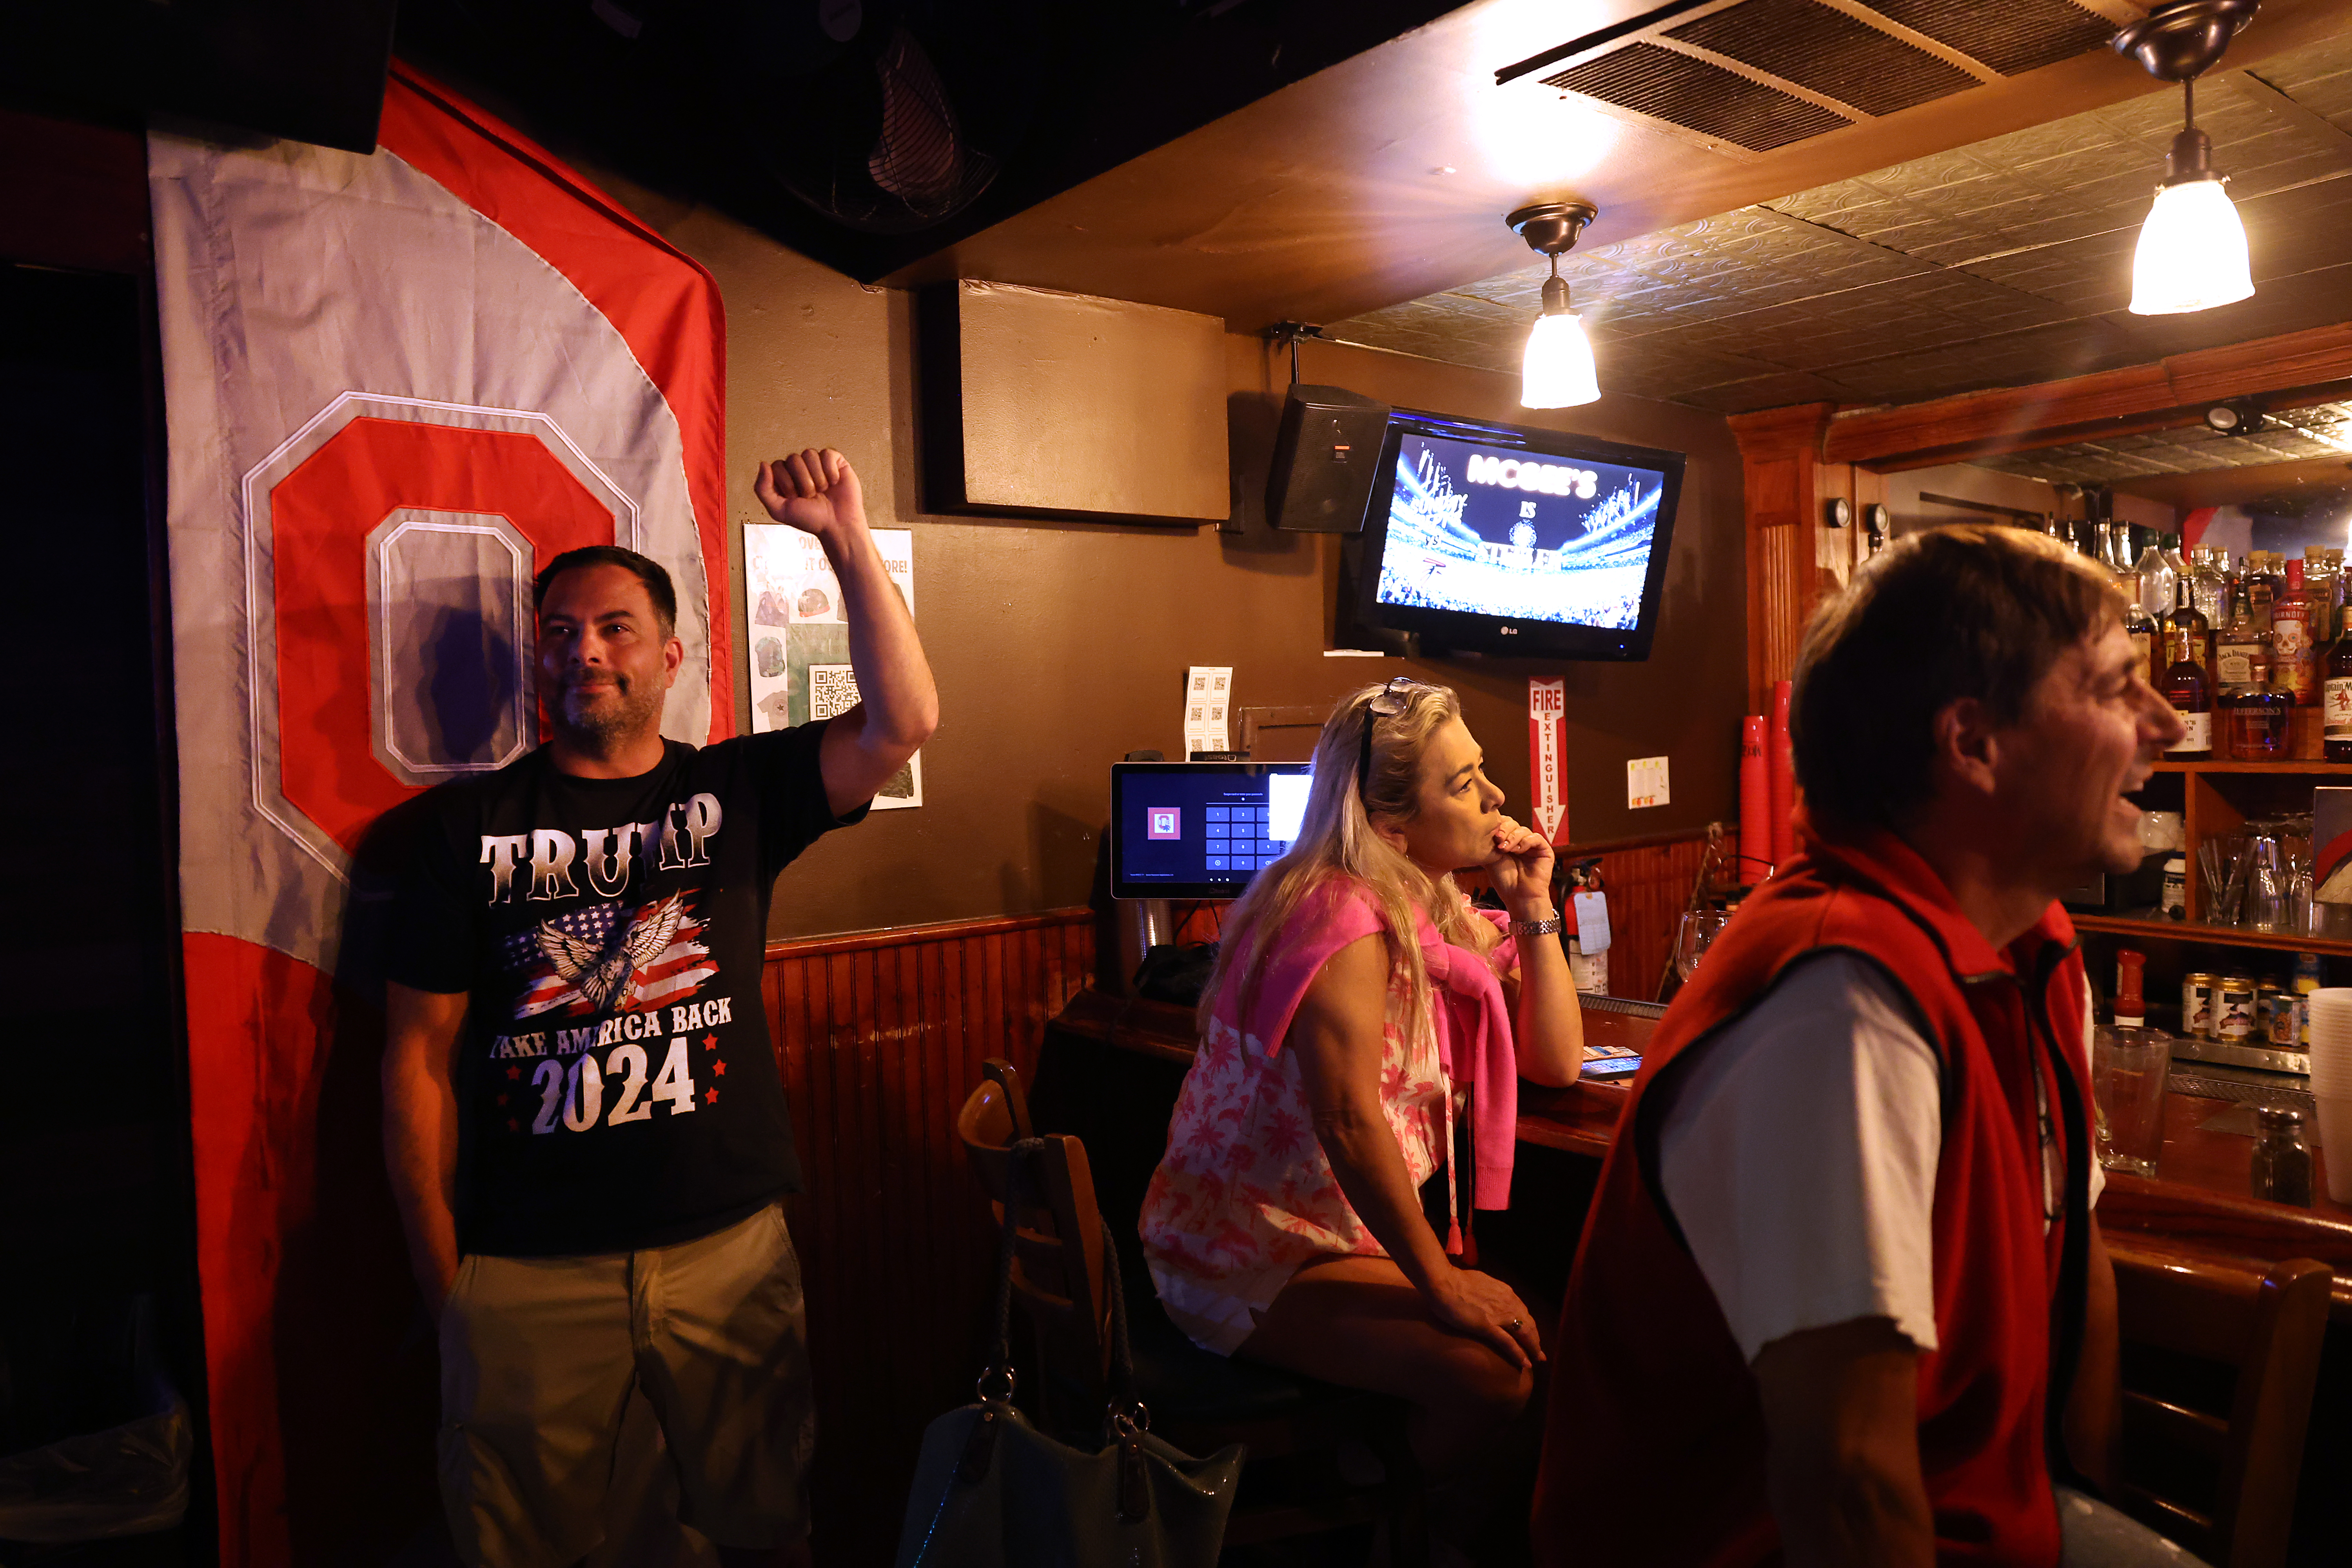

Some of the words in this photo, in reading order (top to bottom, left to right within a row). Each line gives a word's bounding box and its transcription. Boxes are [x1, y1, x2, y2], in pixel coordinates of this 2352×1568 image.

[1519, 501, 1537, 518] IS
[1533, 690, 1561, 711] FIRE
[1544, 712, 1554, 834] EXTINGUISHER
[480, 793, 722, 908] TRUMP
[671, 997, 731, 1034] BACK
[531, 1036, 696, 1135] 2024
